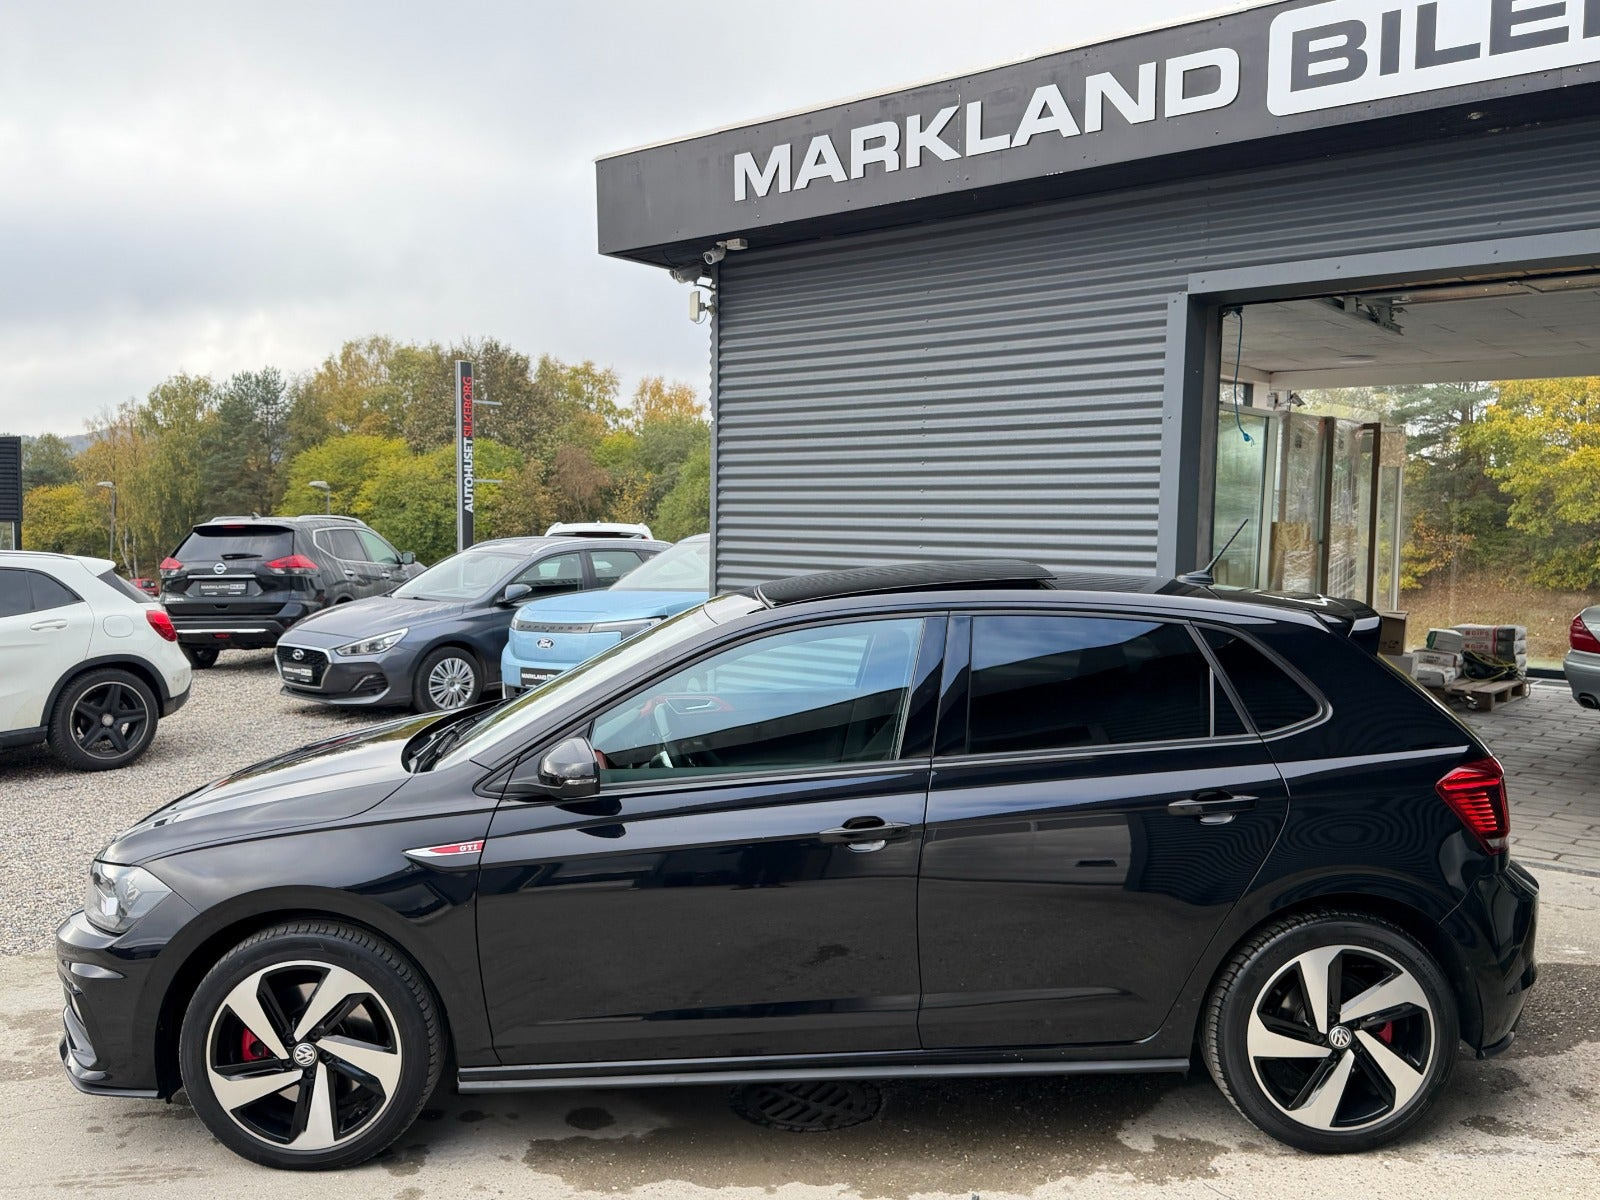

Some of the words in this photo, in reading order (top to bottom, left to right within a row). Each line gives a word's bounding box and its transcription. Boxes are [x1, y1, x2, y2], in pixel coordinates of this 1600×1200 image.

[734, 47, 1240, 202] MARKLAND
[1289, 0, 1600, 92] BILE
[463, 436, 474, 512] AUTOHUSET
[459, 843, 479, 852] GTI
